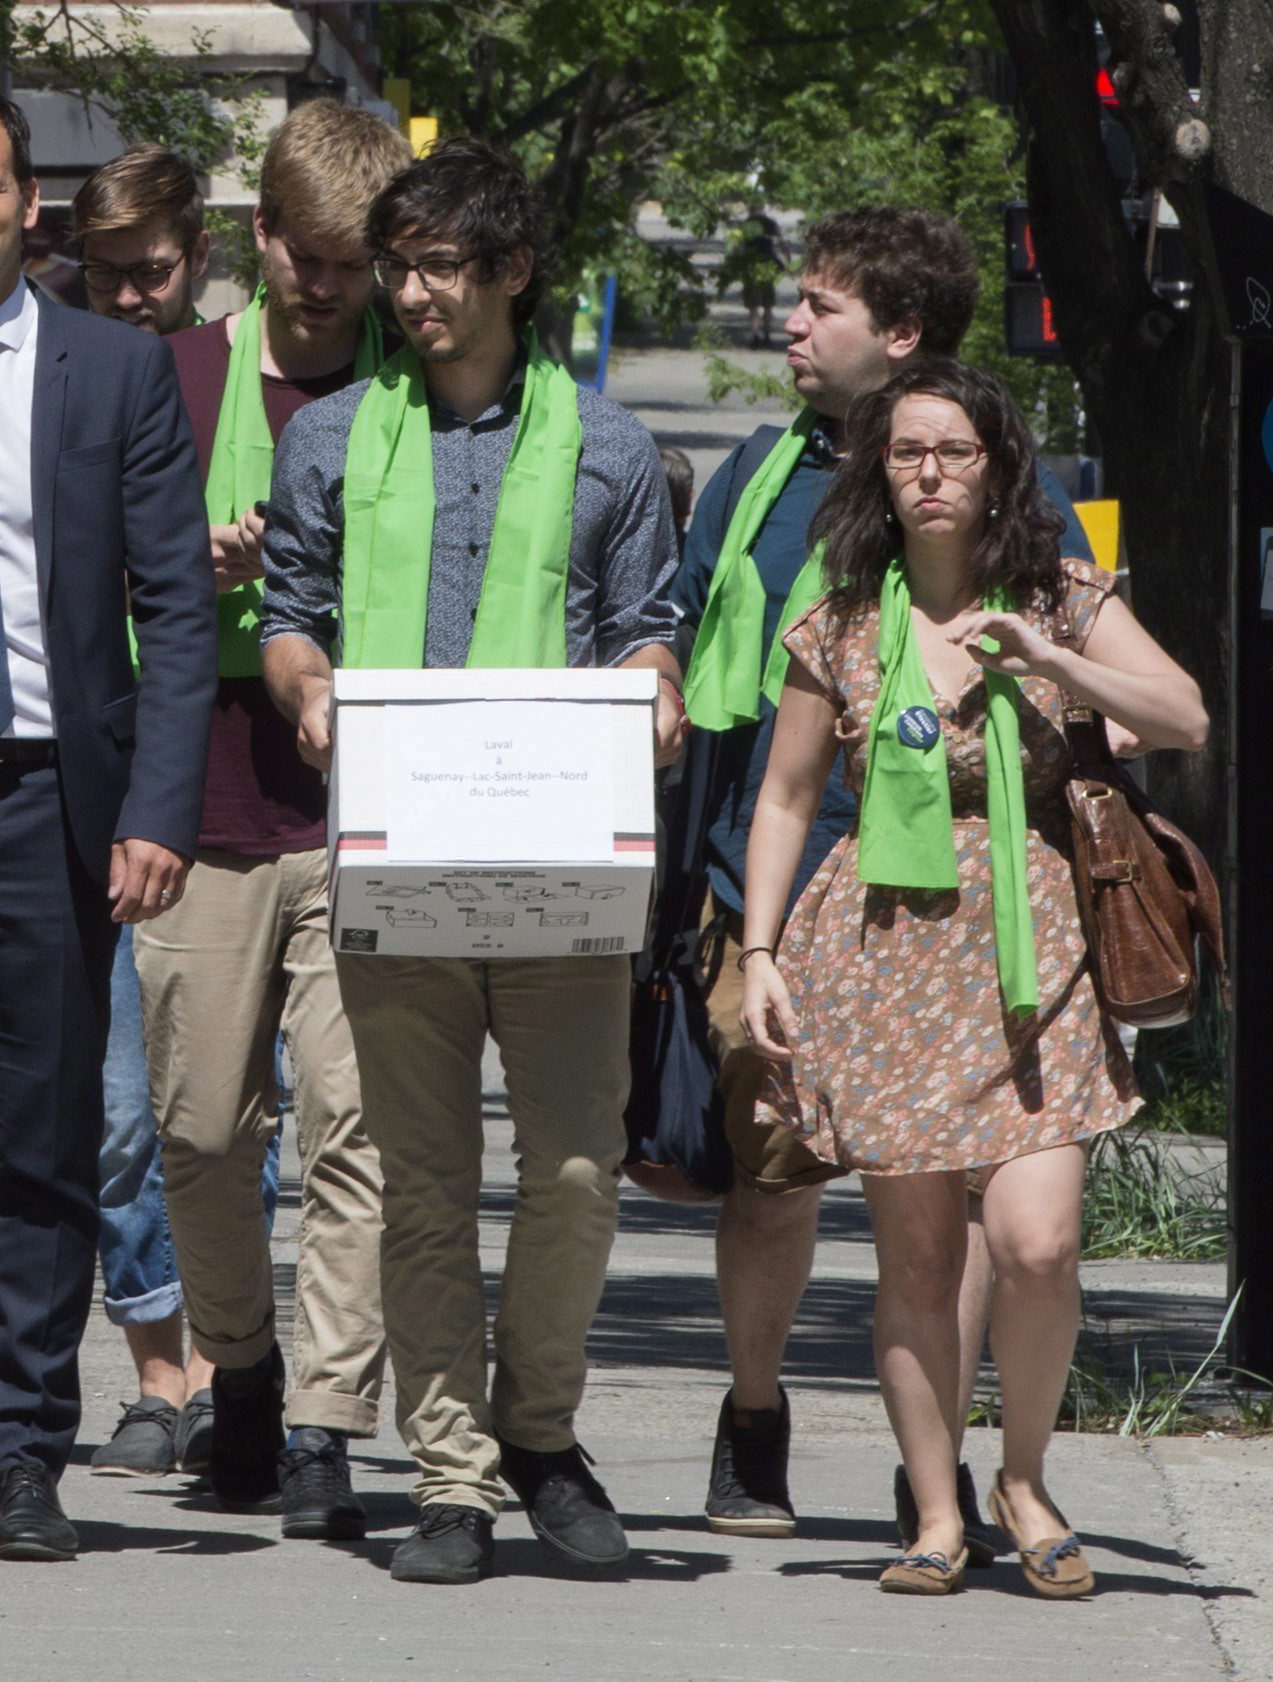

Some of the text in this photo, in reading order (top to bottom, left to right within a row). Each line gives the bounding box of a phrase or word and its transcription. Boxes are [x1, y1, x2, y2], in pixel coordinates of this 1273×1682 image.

[484, 739, 513, 750] Laval
[495, 755, 503, 765] à
[469, 786, 530, 799] du Québec
